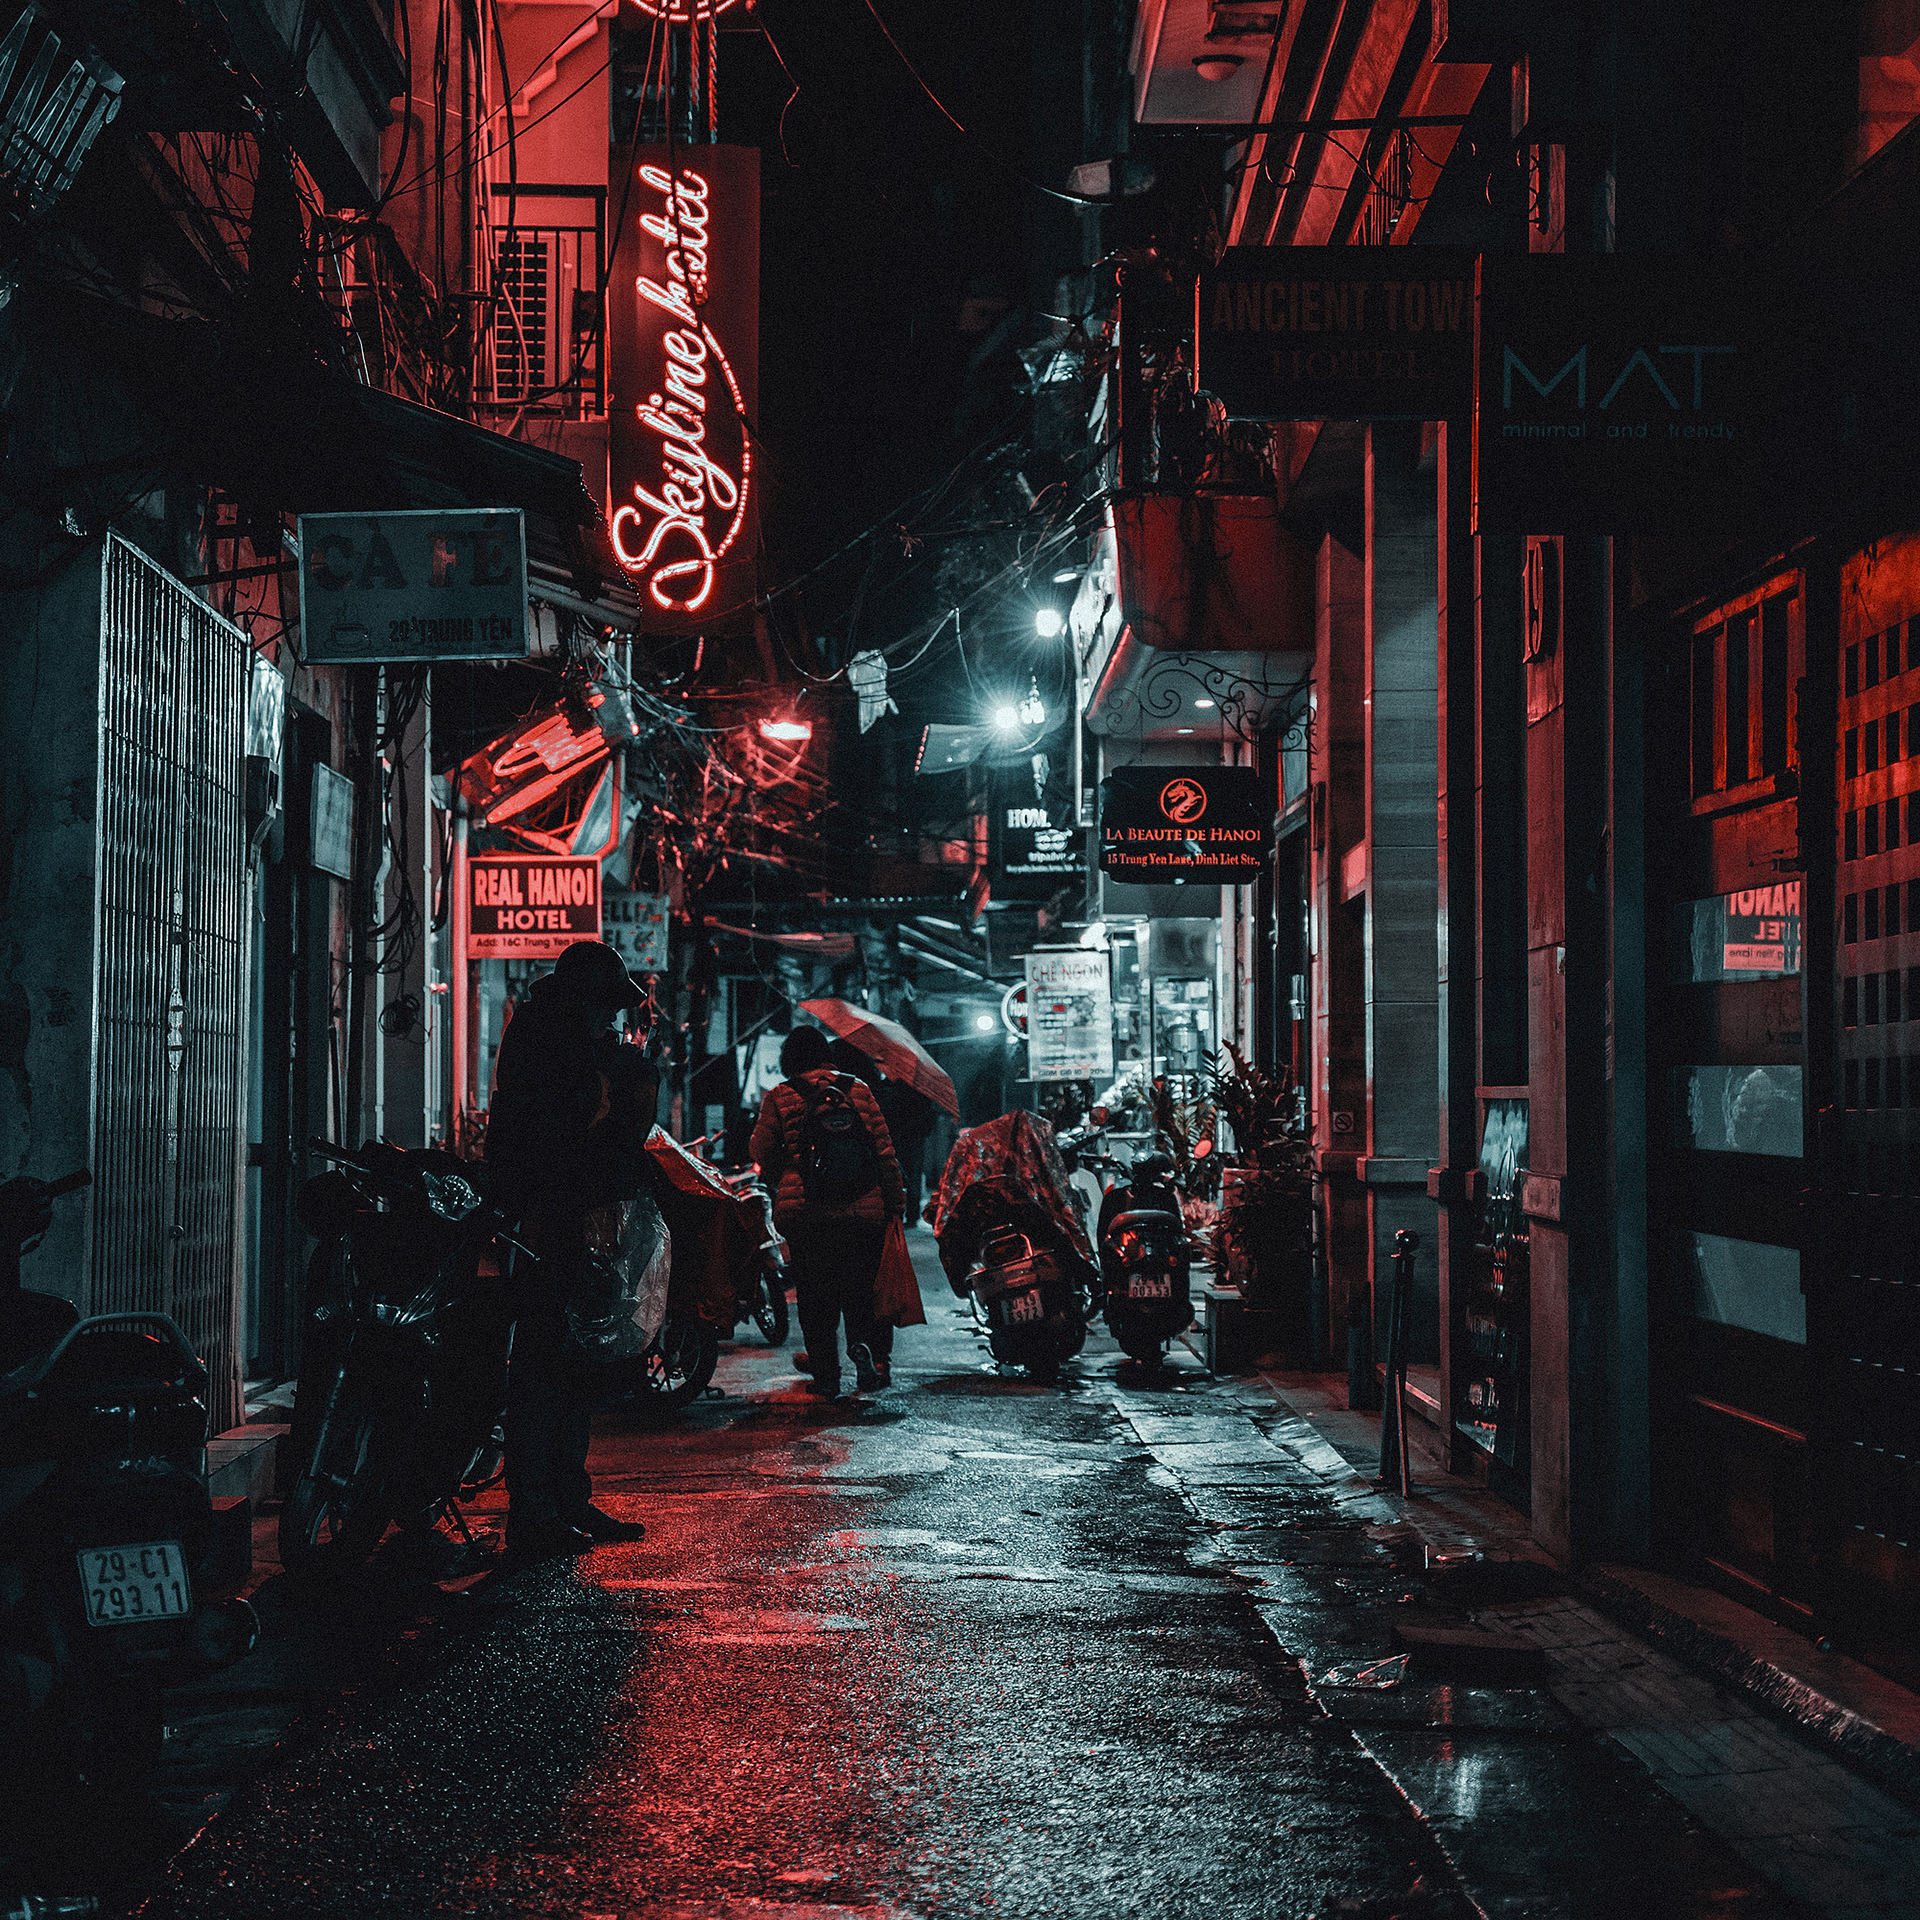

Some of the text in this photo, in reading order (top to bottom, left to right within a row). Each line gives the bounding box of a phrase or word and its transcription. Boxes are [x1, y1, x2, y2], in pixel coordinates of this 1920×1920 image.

[1212, 281, 1369, 333] ANCIENT
[1271, 349, 1432, 379] HOTEL
[1503, 344, 1738, 410] MAT
[1502, 421, 1736, 441] minimal and trendy
[612, 328, 738, 612] Skyline
[419, 618, 473, 642] TRUNG
[1106, 827, 1261, 841] LA BEAUTE DE HANOI
[1107, 853, 1118, 864] 15
[1119, 853, 1148, 867] Trung
[1149, 853, 1167, 865] Yen
[1195, 853, 1219, 865] Dinh
[1220, 853, 1239, 865] Liet
[474, 867, 594, 907] REAL HANOI
[497, 909, 572, 930] HOTEL
[476, 937, 498, 947] Add:
[524, 938, 551, 949] Trung
[94, 1547, 170, 1584] 29-C1
[92, 1581, 184, 1620] 293.11
